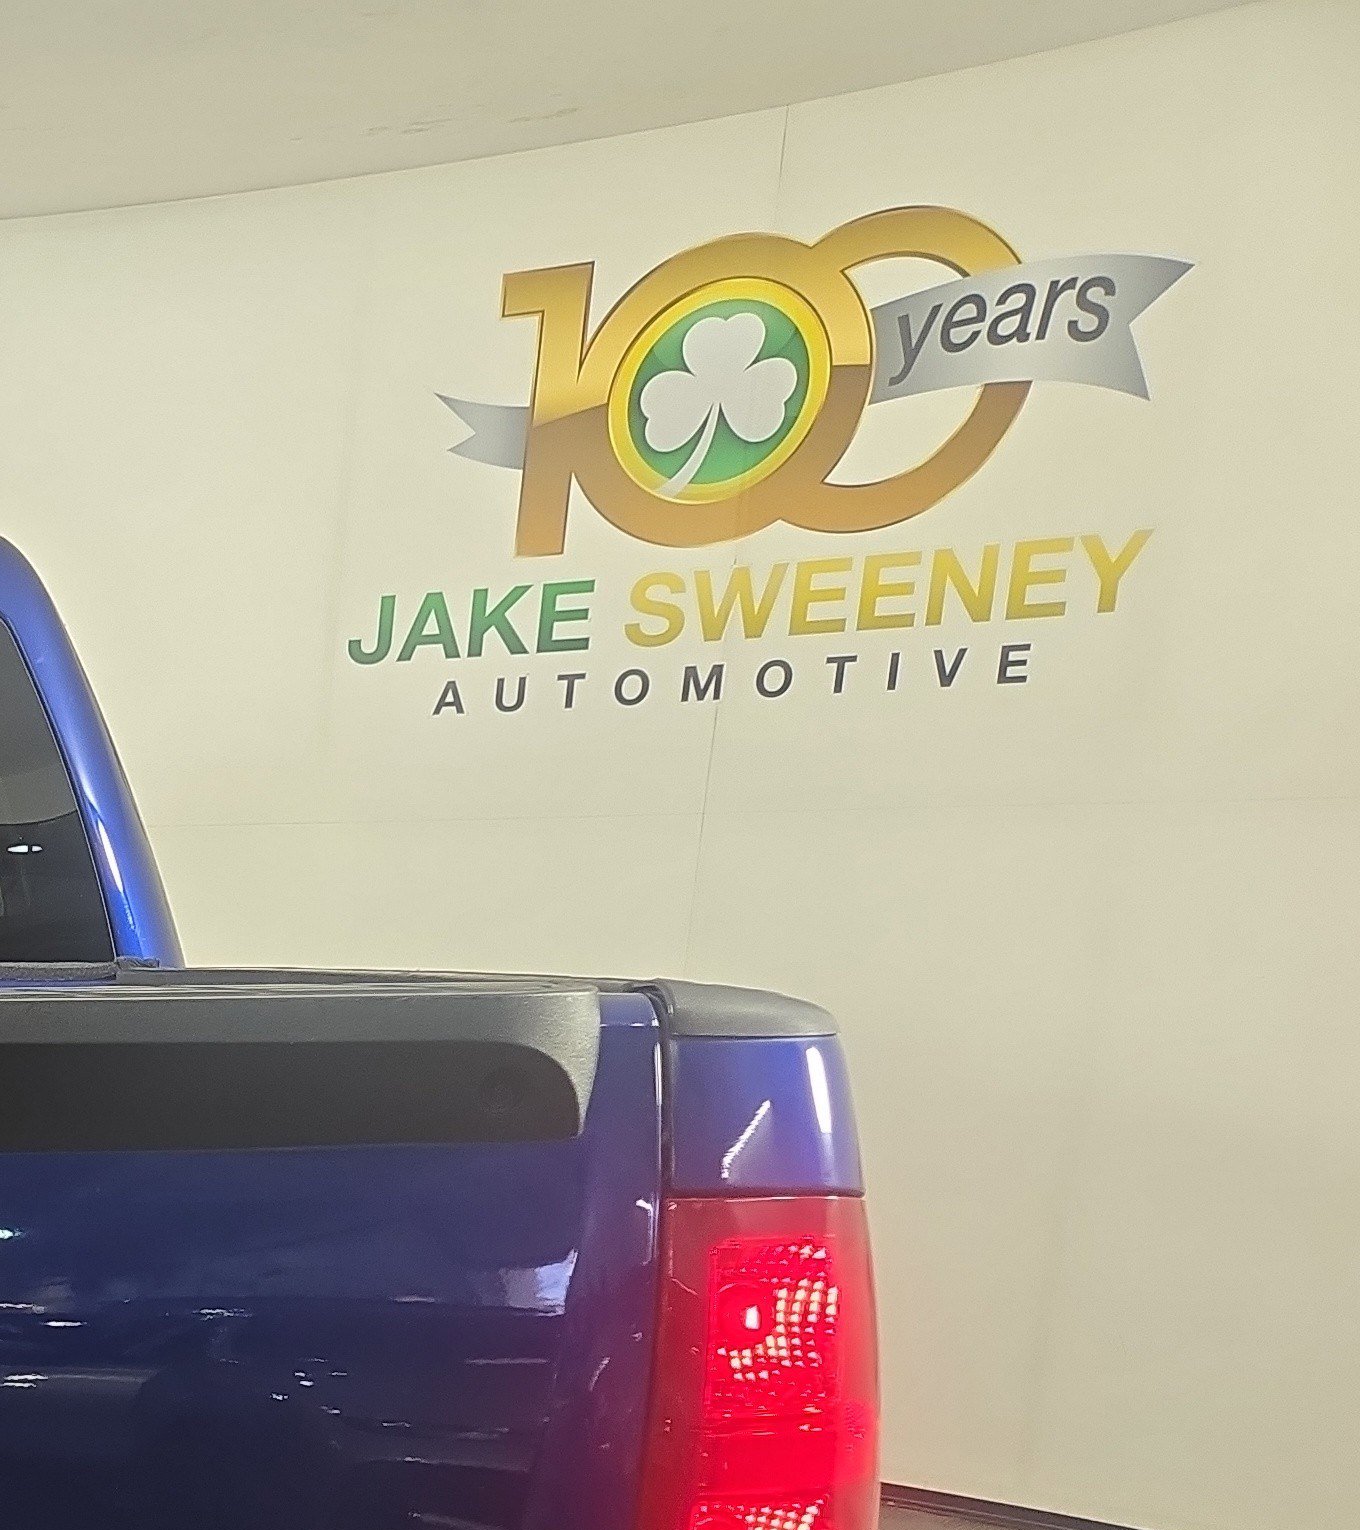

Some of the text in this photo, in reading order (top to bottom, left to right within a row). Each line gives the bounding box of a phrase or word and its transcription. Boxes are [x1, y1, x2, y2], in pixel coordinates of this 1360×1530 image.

[498, 205, 1033, 559] 100
[888, 274, 1117, 388] years
[347, 528, 1155, 666] JAKE SWEENEY
[432, 643, 1033, 716] AUTOMOTIVE
